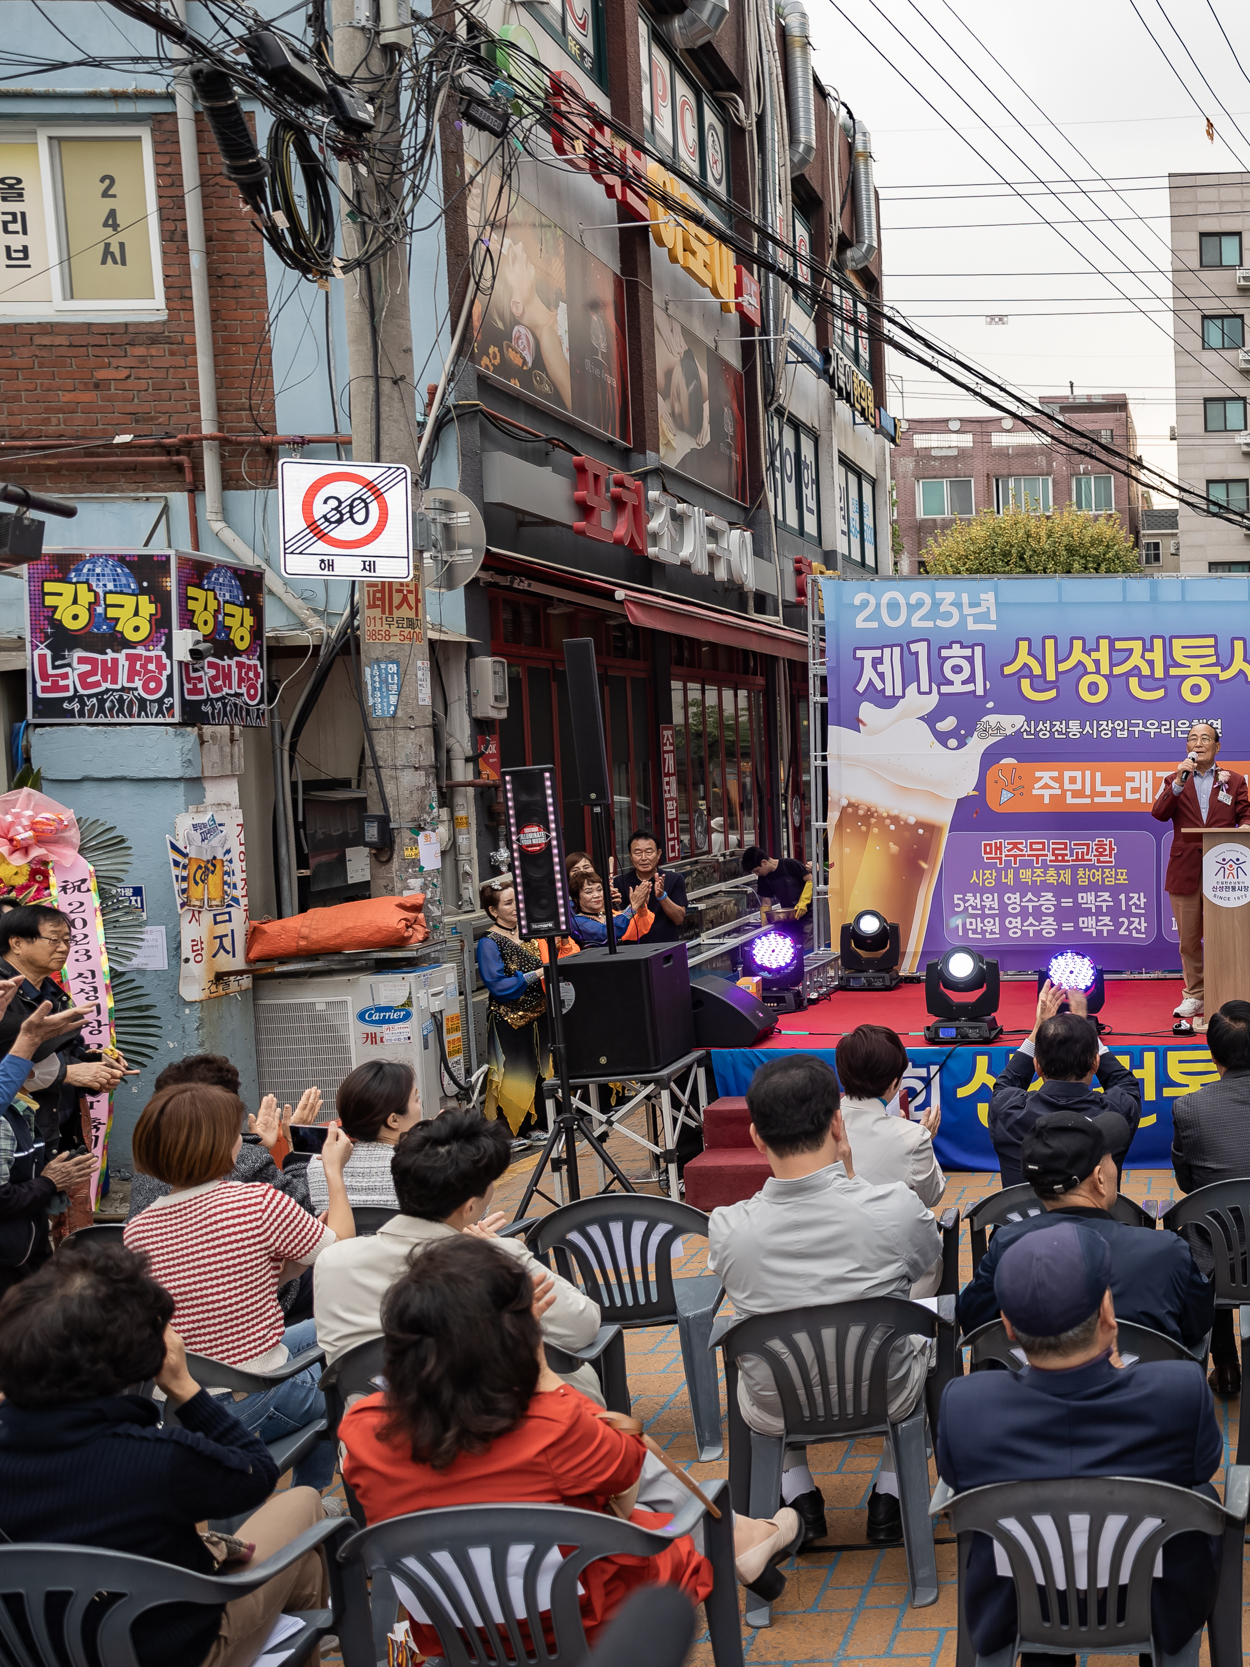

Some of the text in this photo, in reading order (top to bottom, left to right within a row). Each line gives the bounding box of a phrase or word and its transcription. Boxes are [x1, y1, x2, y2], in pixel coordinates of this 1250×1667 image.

[321, 496, 370, 526] 30
[365, 580, 422, 618] 폐차
[853, 590, 998, 631] 2023년
[853, 639, 985, 698] 제1회
[981, 837, 1117, 867] 맥주무료교환
[969, 867, 1128, 887] 시장 내 맥주축제 참여점포
[953, 892, 999, 914] 5천원
[1003, 891, 1057, 914] 영수증
[1077, 891, 1114, 913] 맥주
[1118, 891, 1147, 913] 1잔
[955, 917, 1000, 938] 1만원
[1005, 916, 1058, 938] 영수증
[1078, 915, 1115, 937] 맥주
[1119, 916, 1148, 938] 2잔
[364, 1009, 406, 1021] Carrier
